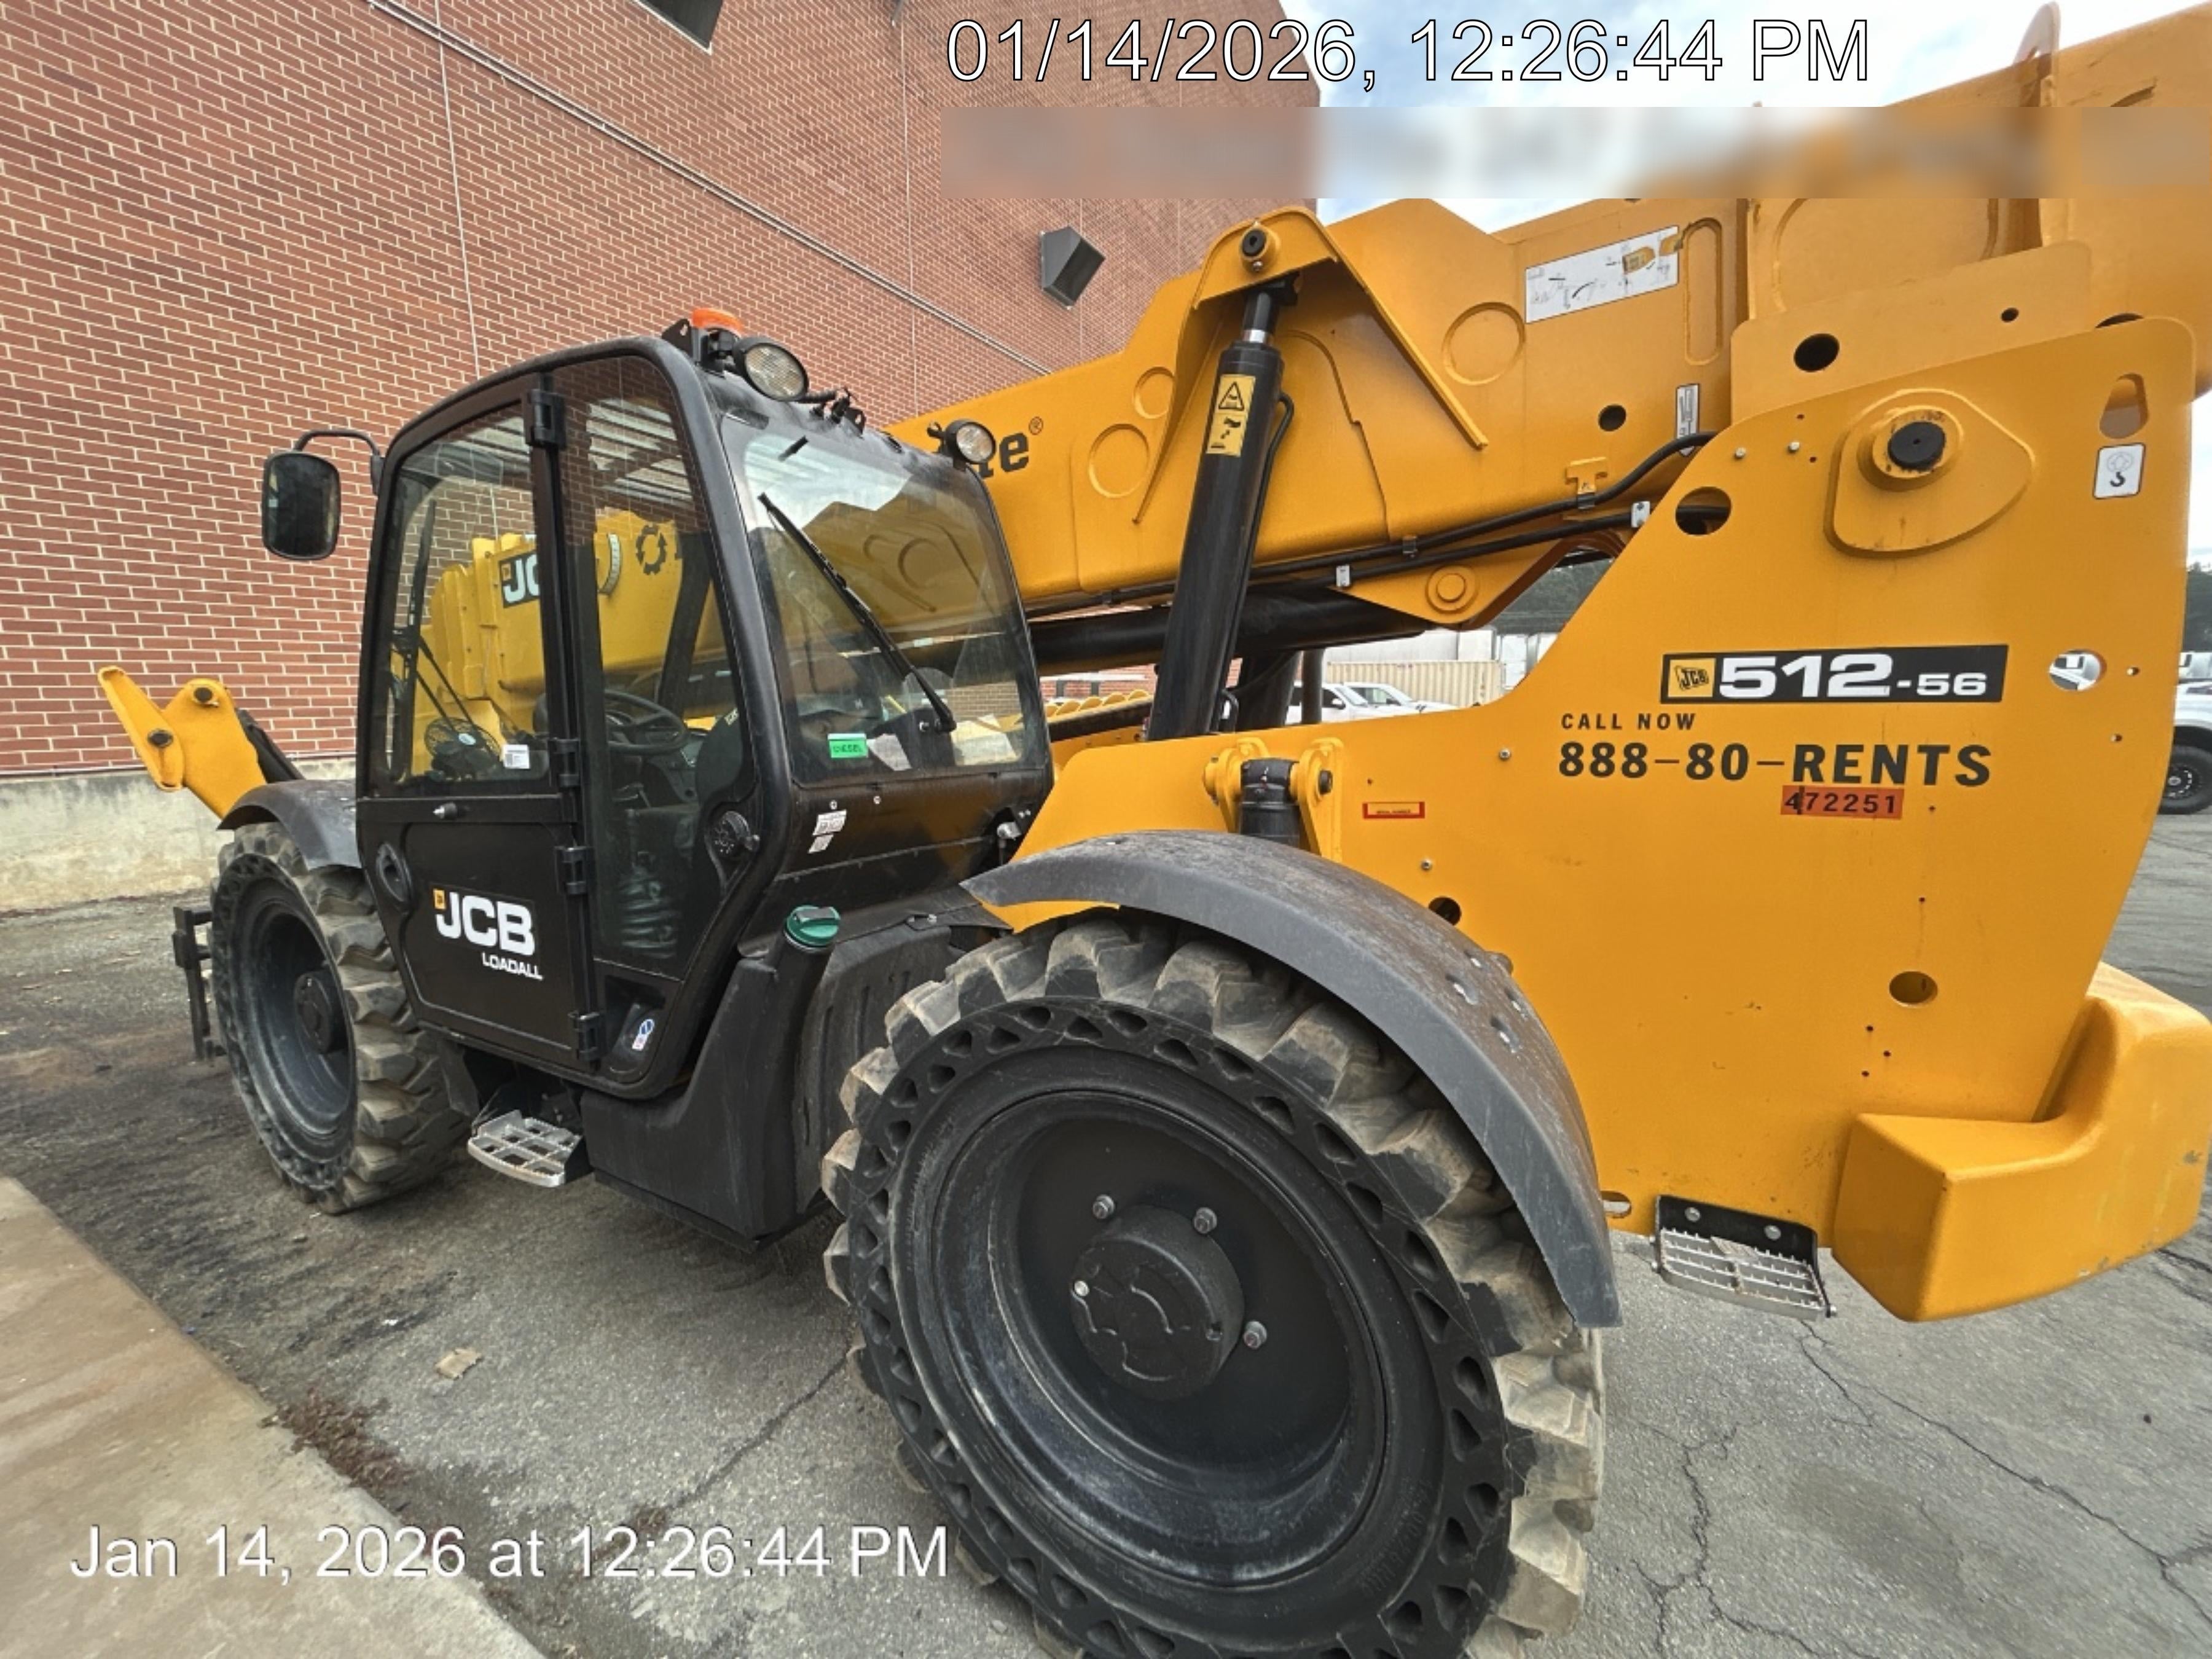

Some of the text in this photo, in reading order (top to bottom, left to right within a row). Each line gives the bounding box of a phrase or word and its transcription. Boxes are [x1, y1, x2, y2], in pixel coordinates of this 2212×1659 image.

[1719, 653, 1986, 699] 512-56
[1561, 713, 1696, 731] CALL NOW
[1558, 741, 1991, 787] 888-80-RENTS
[1784, 791, 1896, 815] 472251
[436, 892, 535, 956] JCB
[481, 952, 543, 981] LOADALL
